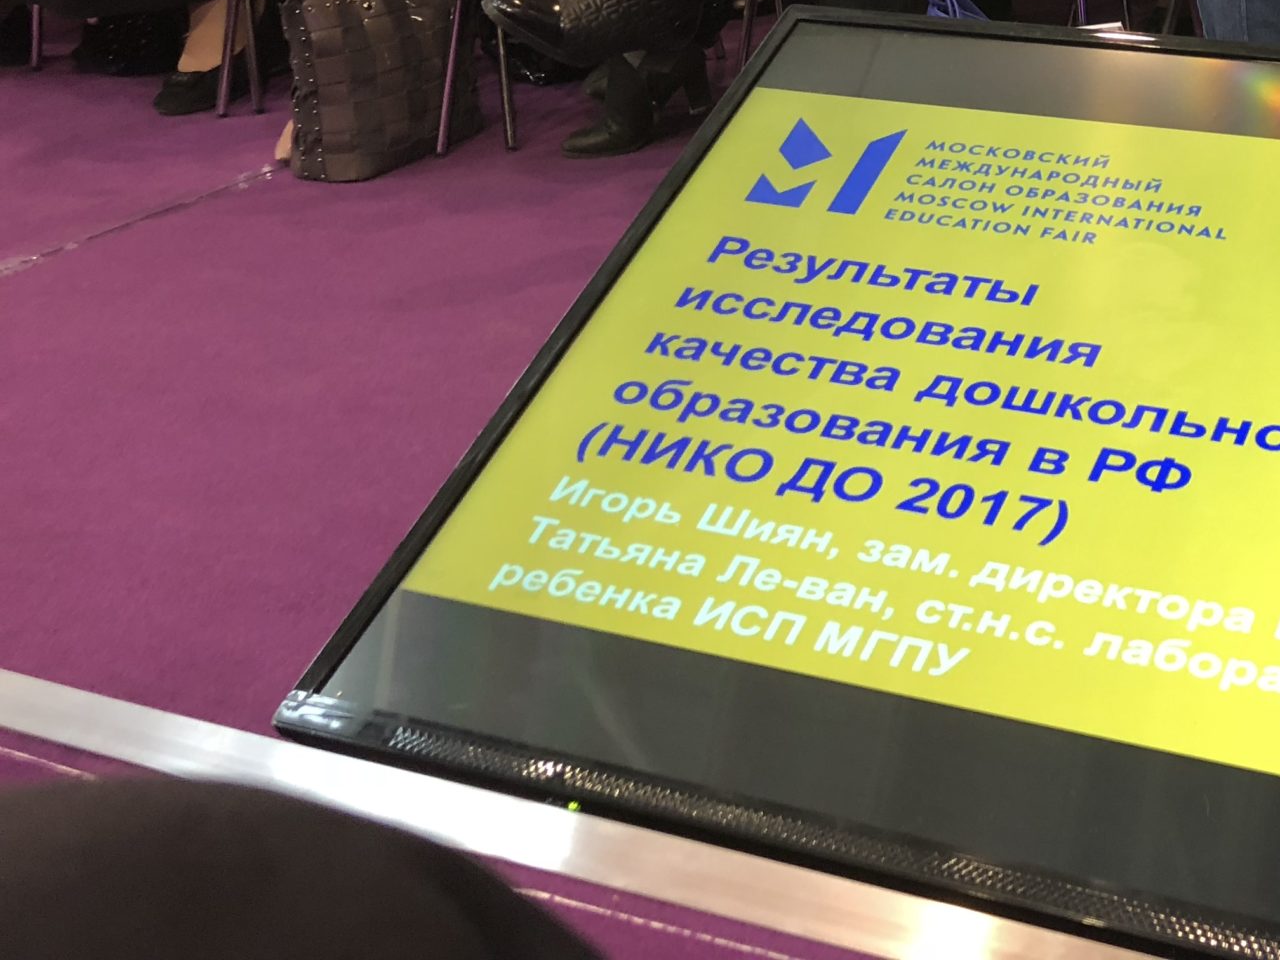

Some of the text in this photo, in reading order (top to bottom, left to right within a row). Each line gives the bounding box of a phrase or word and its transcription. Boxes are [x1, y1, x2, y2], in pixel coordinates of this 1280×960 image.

[915, 157, 1163, 193] МЕЖДУНАРОДНЫЙ
[926, 140, 1111, 169] МОСКОВСКИЙ
[884, 208, 1098, 244] EDUCATION FAIR
[894, 192, 1227, 240] MOSCOW INTERNATIONAL
[906, 174, 1202, 217] САЛОН ОБРАЗОВАНИЯ
[707, 235, 1039, 306] Результаты
[645, 332, 901, 391] качества
[674, 287, 1102, 367] исследования
[613, 379, 1192, 493] образования в РФ
[576, 422, 1069, 547] (НИКО ДО 2017)
[525, 515, 706, 579] Татьяна
[716, 553, 896, 622] Ле-ван,
[916, 599, 1064, 649] ст.н.с.
[549, 474, 681, 528] Игорь
[696, 502, 841, 561] Шиян,
[856, 538, 959, 579] зам.
[969, 561, 1255, 634] директора
[488, 561, 972, 677] ребенка ИСП МГПУ
